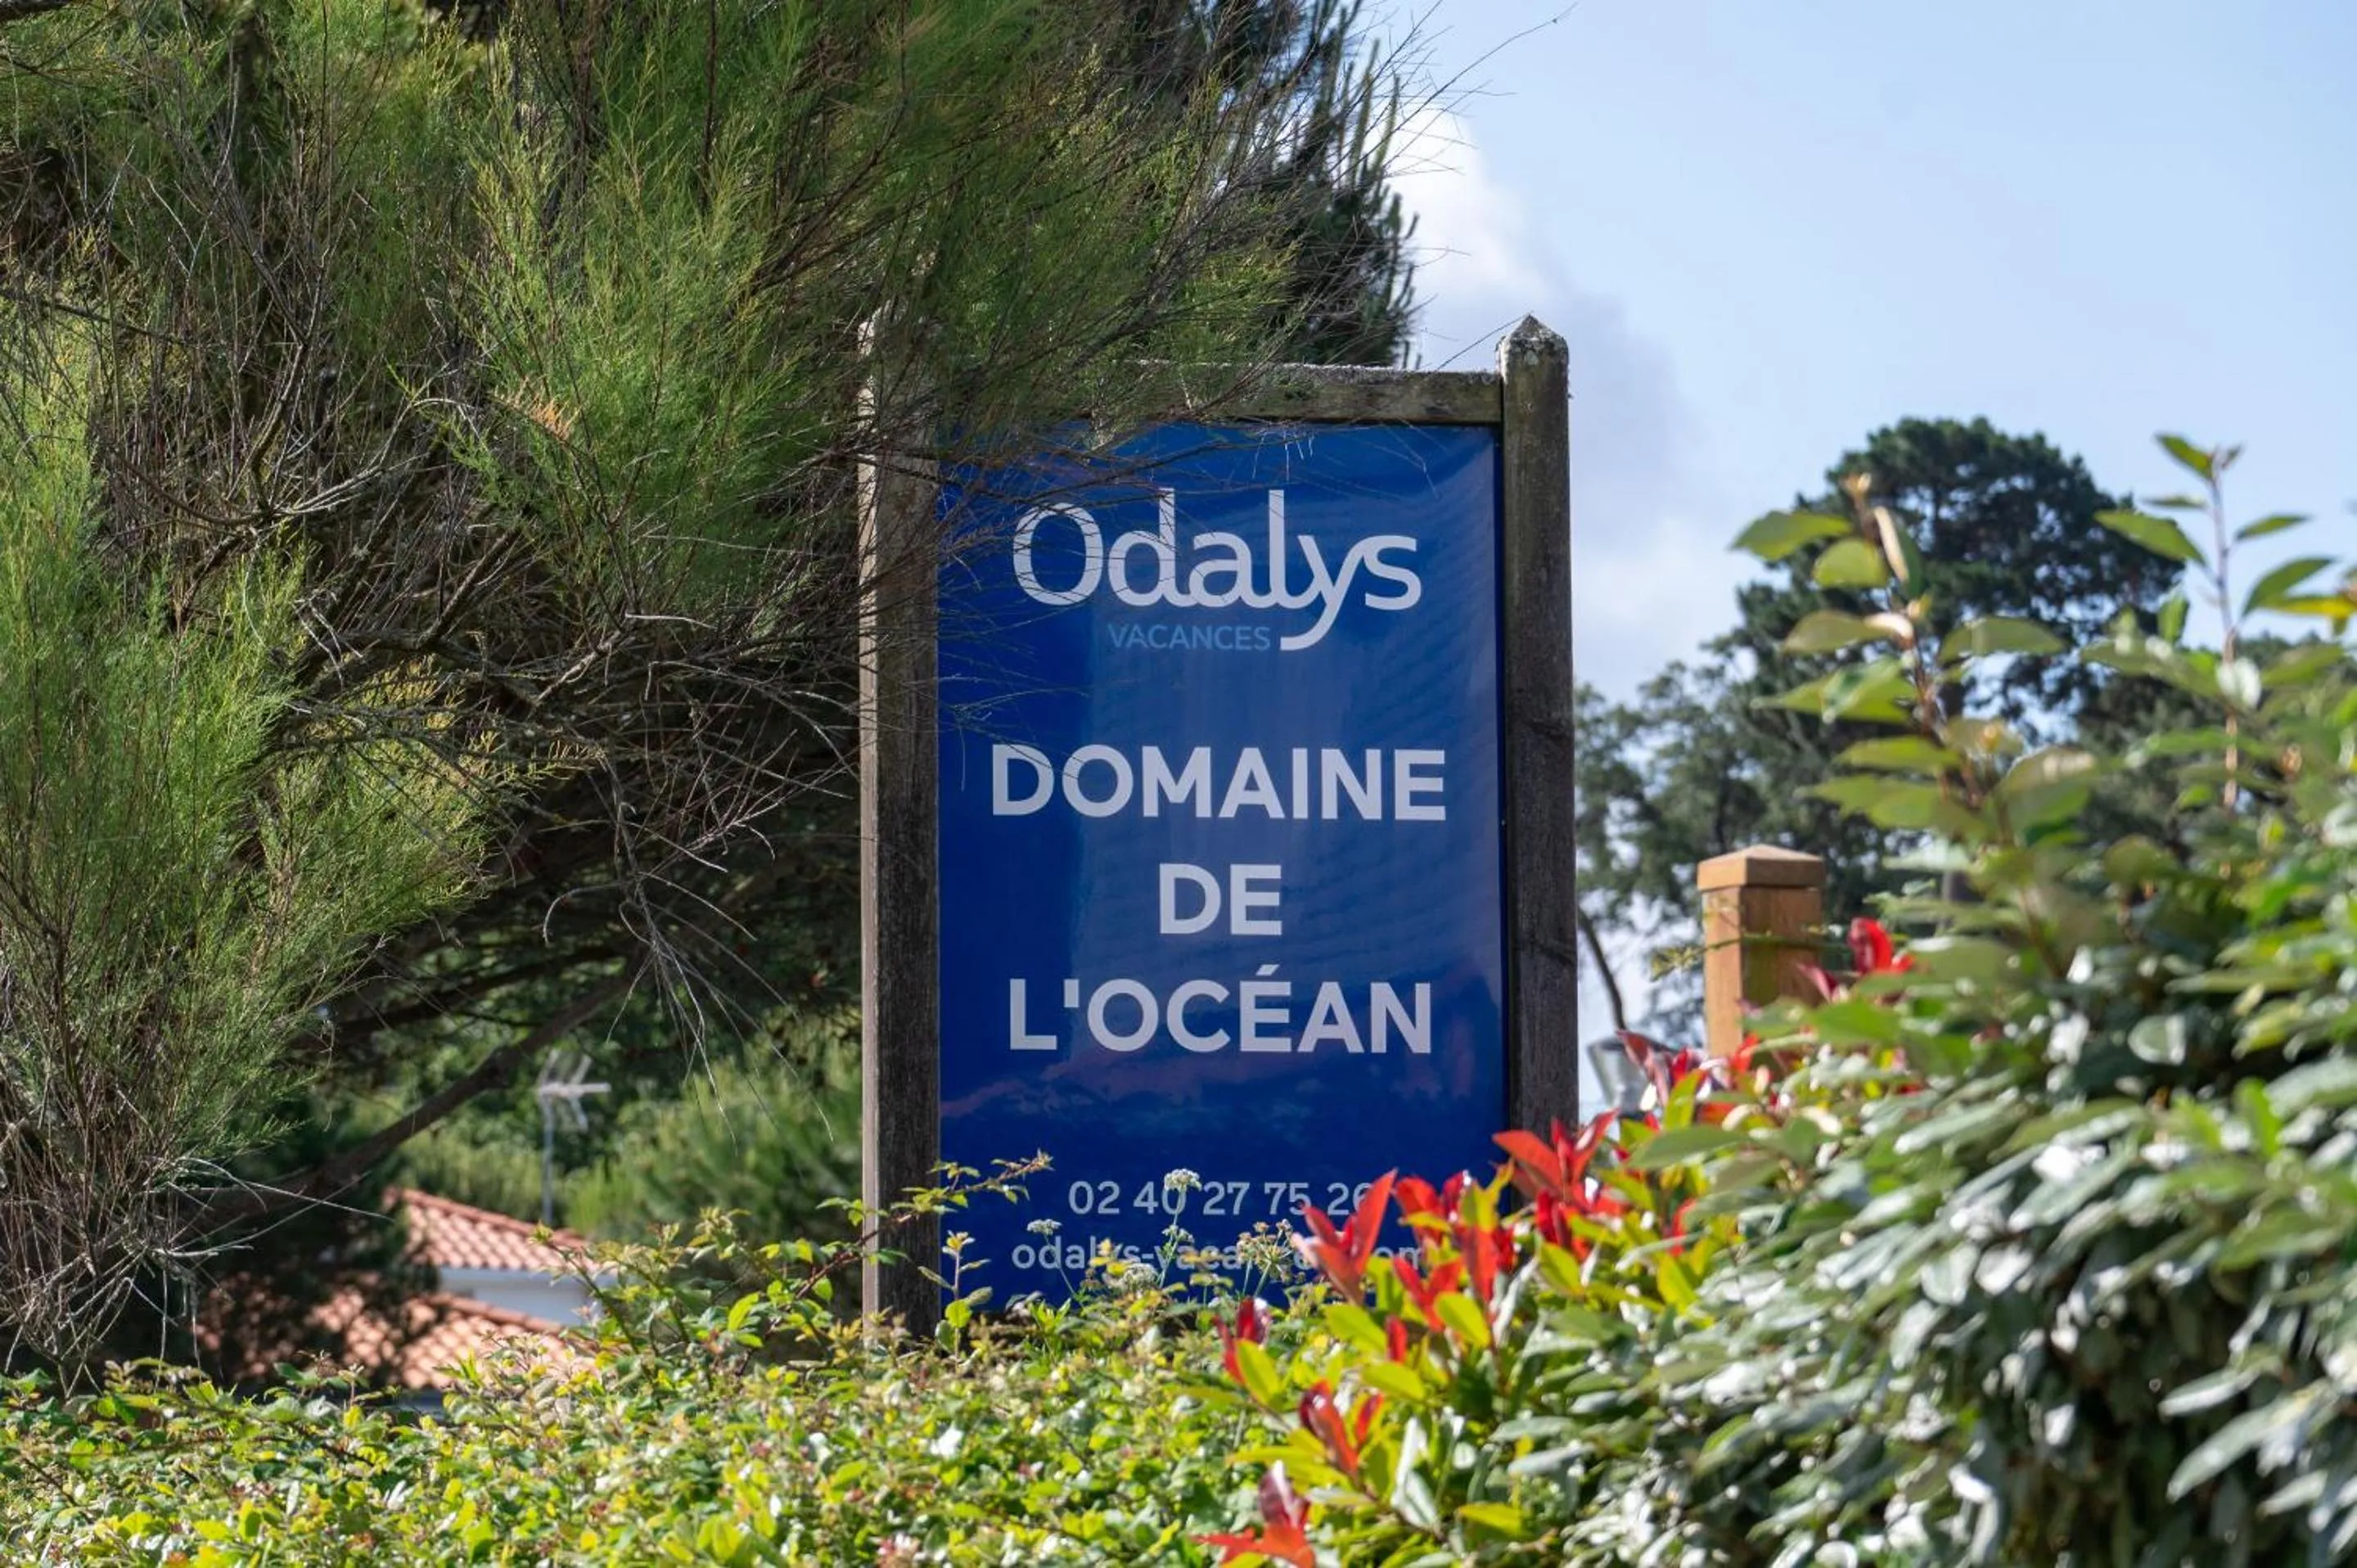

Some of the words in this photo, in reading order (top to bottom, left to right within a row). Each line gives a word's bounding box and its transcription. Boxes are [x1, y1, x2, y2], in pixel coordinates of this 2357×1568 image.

[1012, 488, 1422, 651] Odalys
[1107, 624, 1271, 651] VACANCES
[992, 744, 1447, 821] DOMAINE
[1159, 863, 1282, 935] DE
[1009, 964, 1431, 1054] L'OCÉAN
[1068, 1181, 1120, 1215] 02
[1133, 1181, 1187, 1215] 40
[1202, 1181, 1251, 1216] 27
[1264, 1182, 1312, 1216] 75
